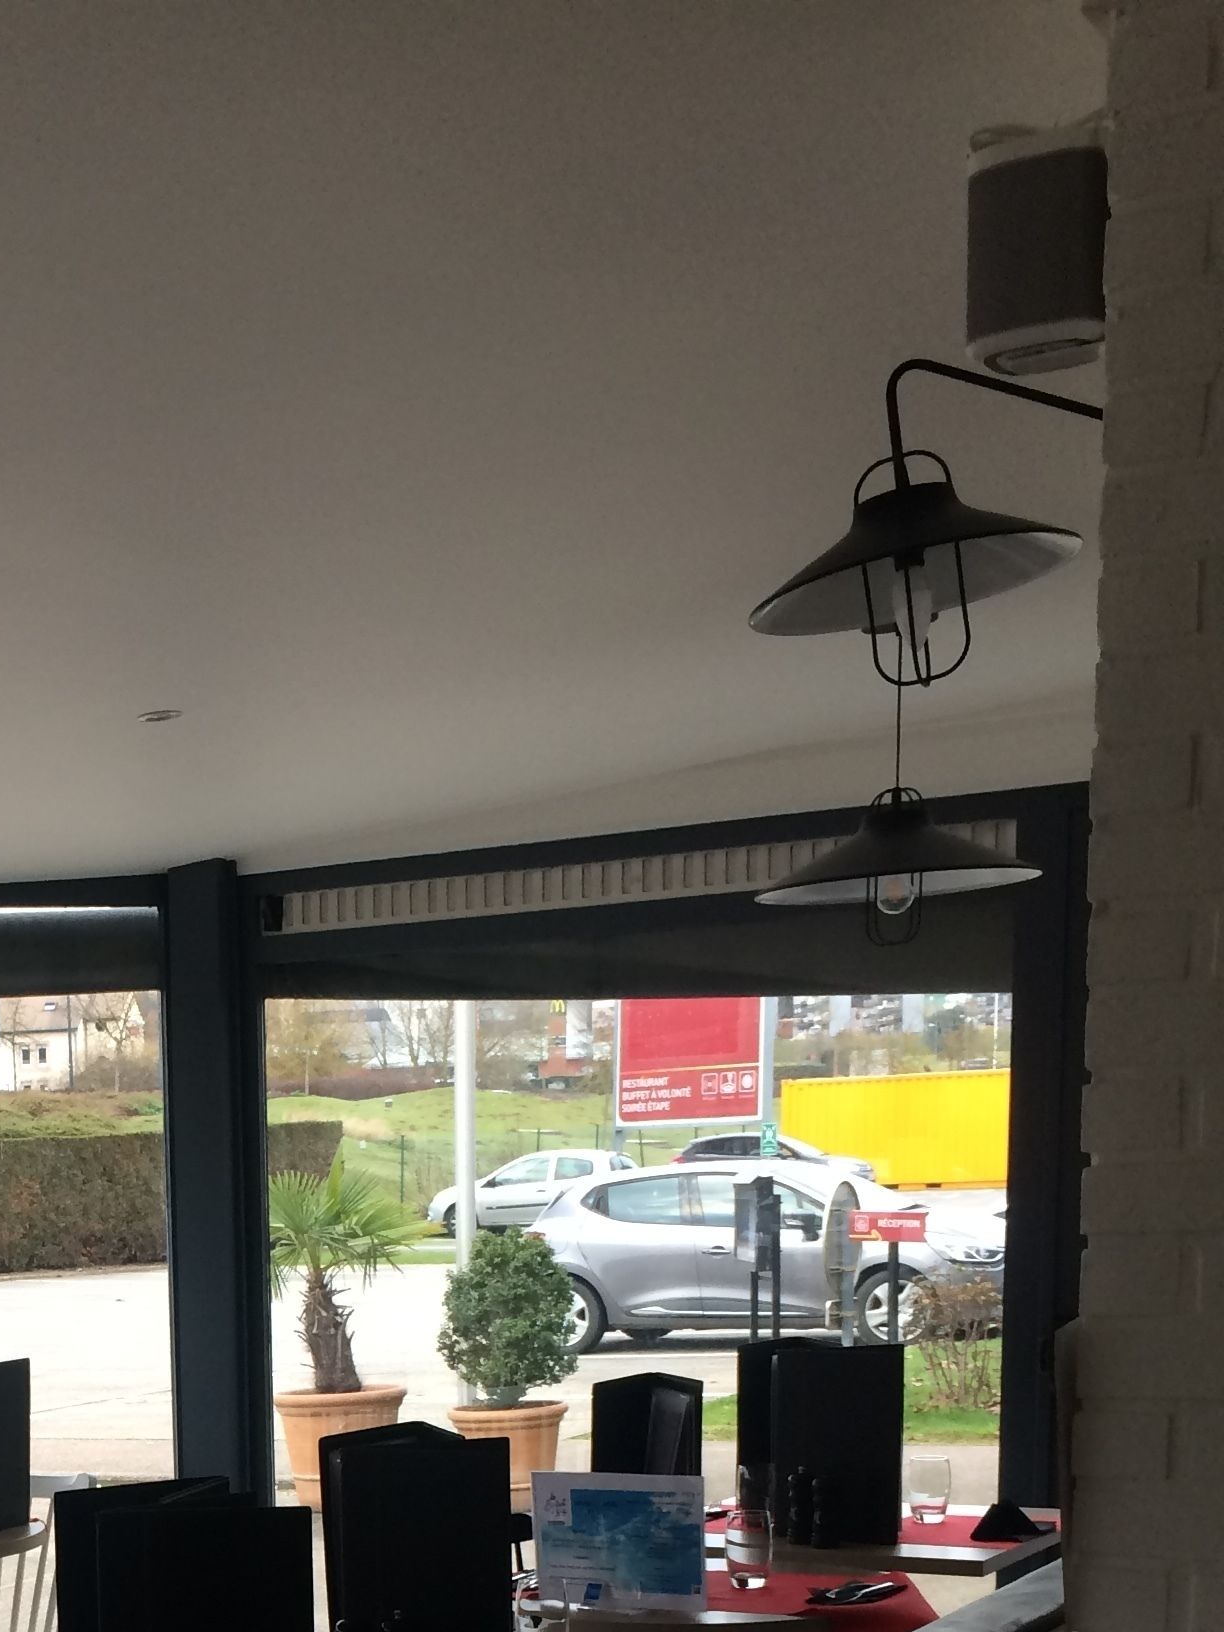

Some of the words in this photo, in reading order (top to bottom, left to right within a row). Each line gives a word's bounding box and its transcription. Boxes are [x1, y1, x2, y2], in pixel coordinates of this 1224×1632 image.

[622, 1077, 669, 1088] RESTAURANT
[622, 1090, 650, 1101] BUFFET
[657, 1086, 692, 1098] VOLONTÉ
[622, 1101, 647, 1113] SOIRÉE
[647, 1101, 671, 1112] ÉTAPE
[877, 1218, 921, 1228] RÉCEPTION
